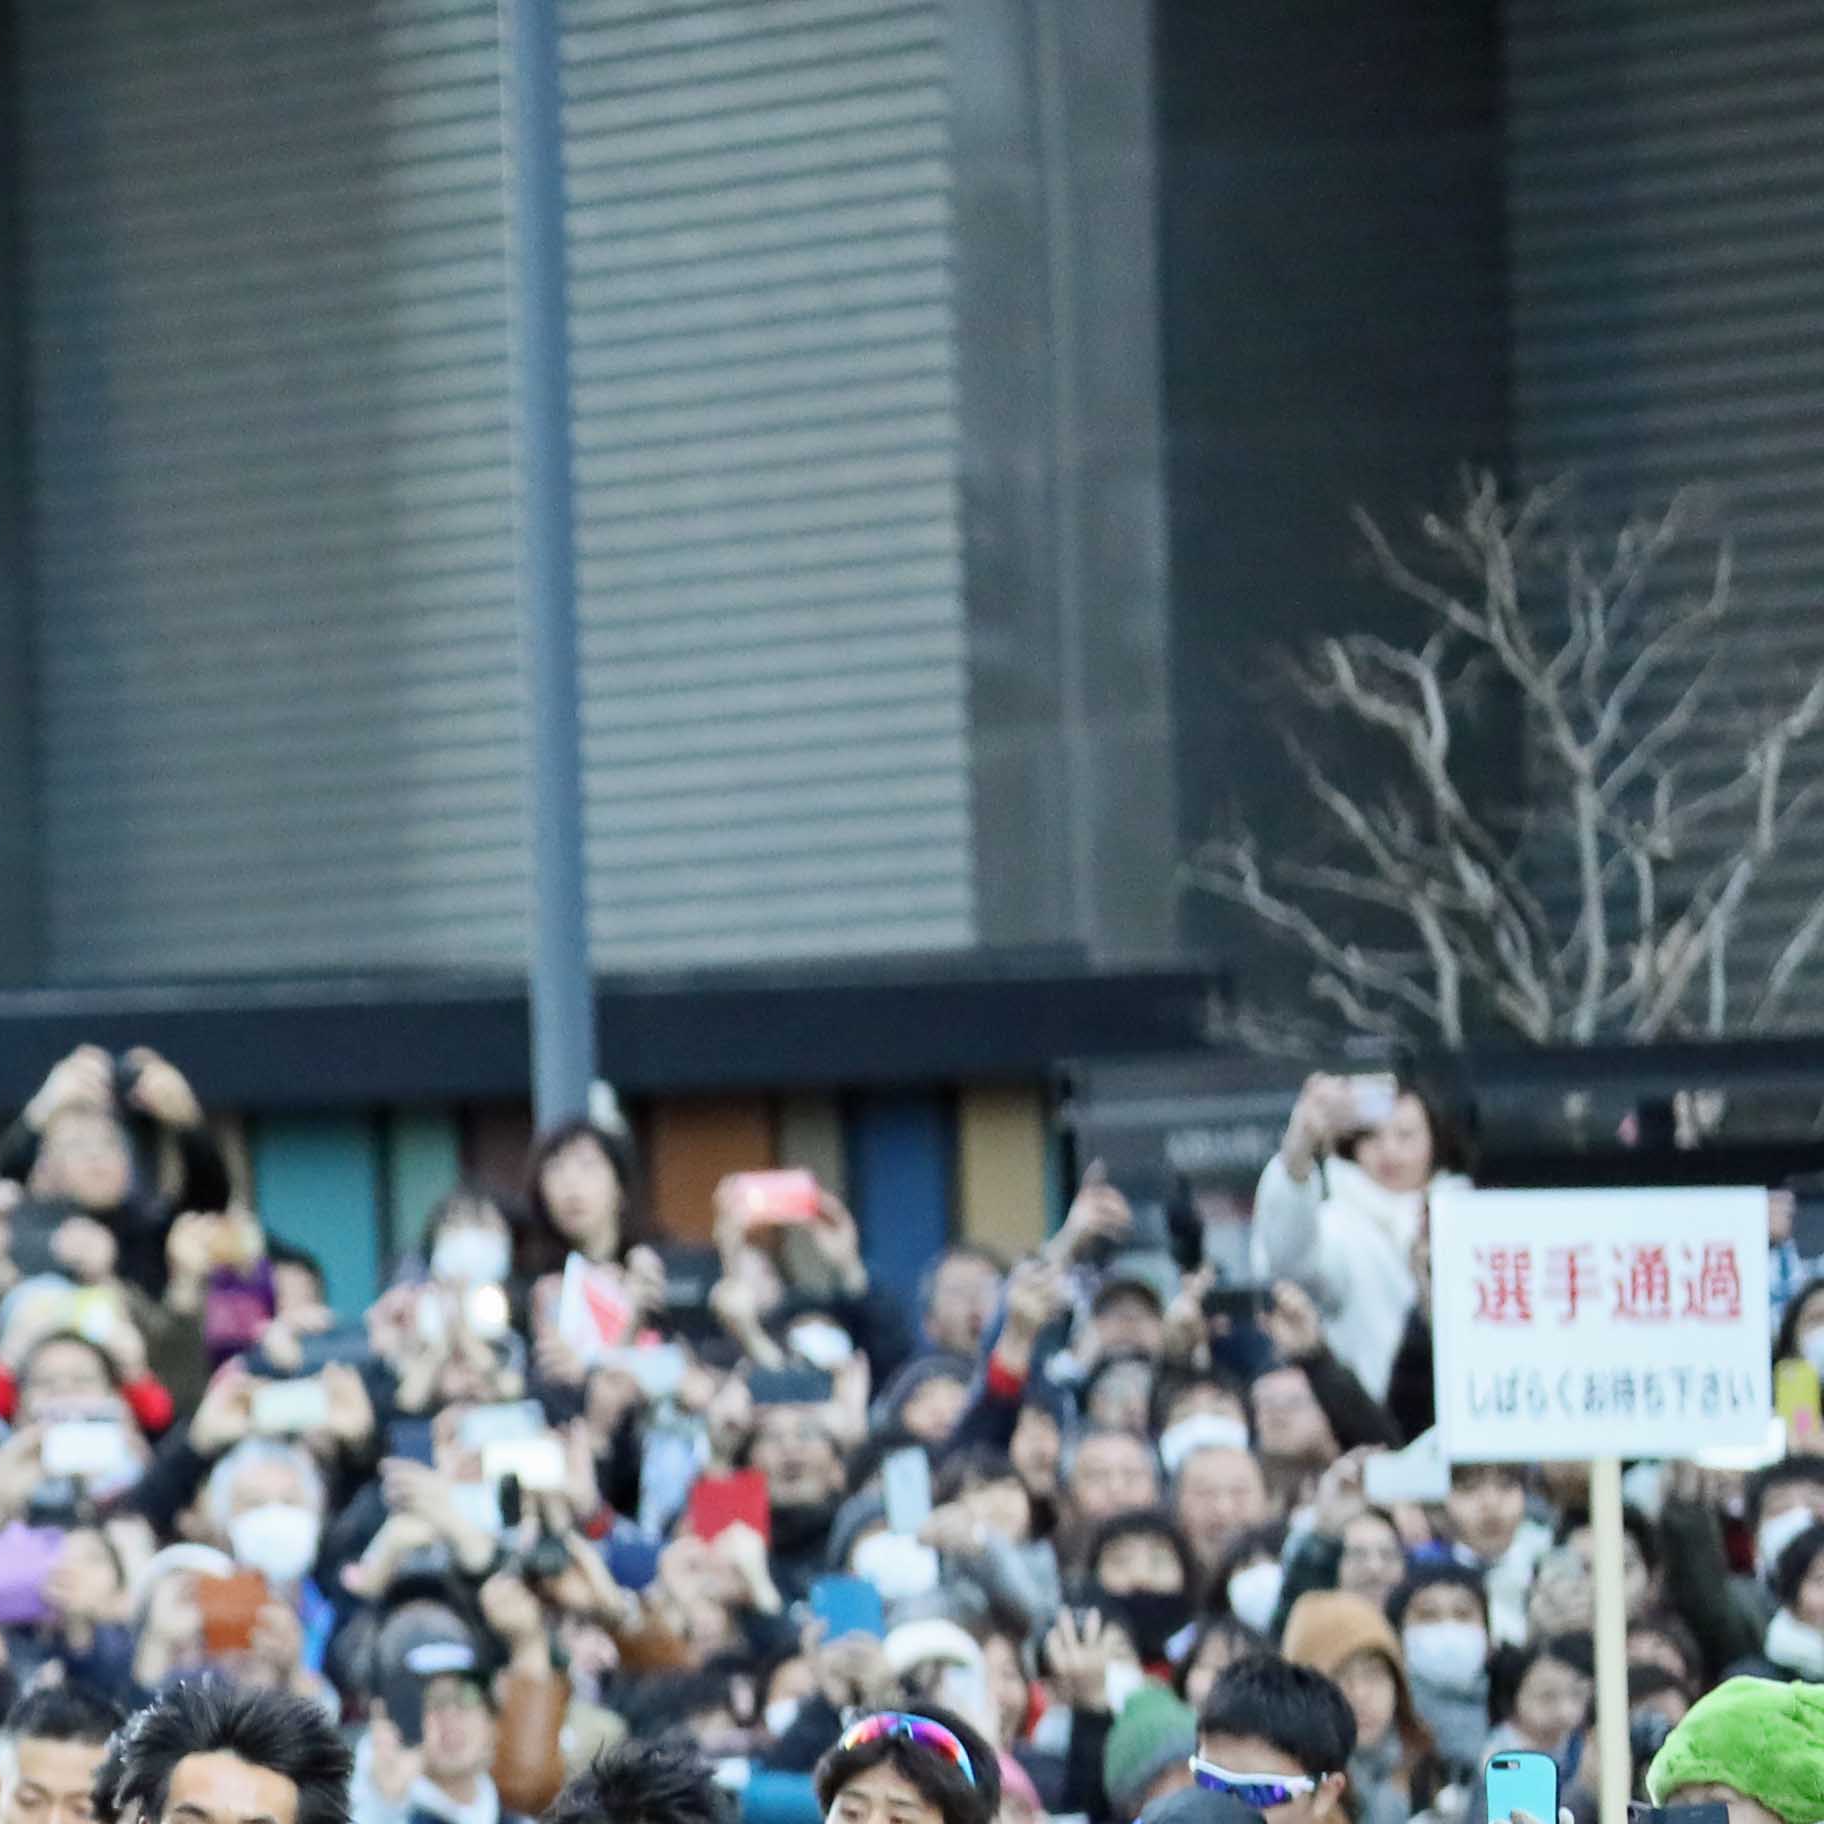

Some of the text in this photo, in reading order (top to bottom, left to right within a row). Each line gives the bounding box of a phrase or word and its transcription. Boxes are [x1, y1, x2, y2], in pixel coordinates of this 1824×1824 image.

[1473, 1239, 1742, 1324] 選手通過
[1467, 1367, 1756, 1418] しばらくお待ち下さい
